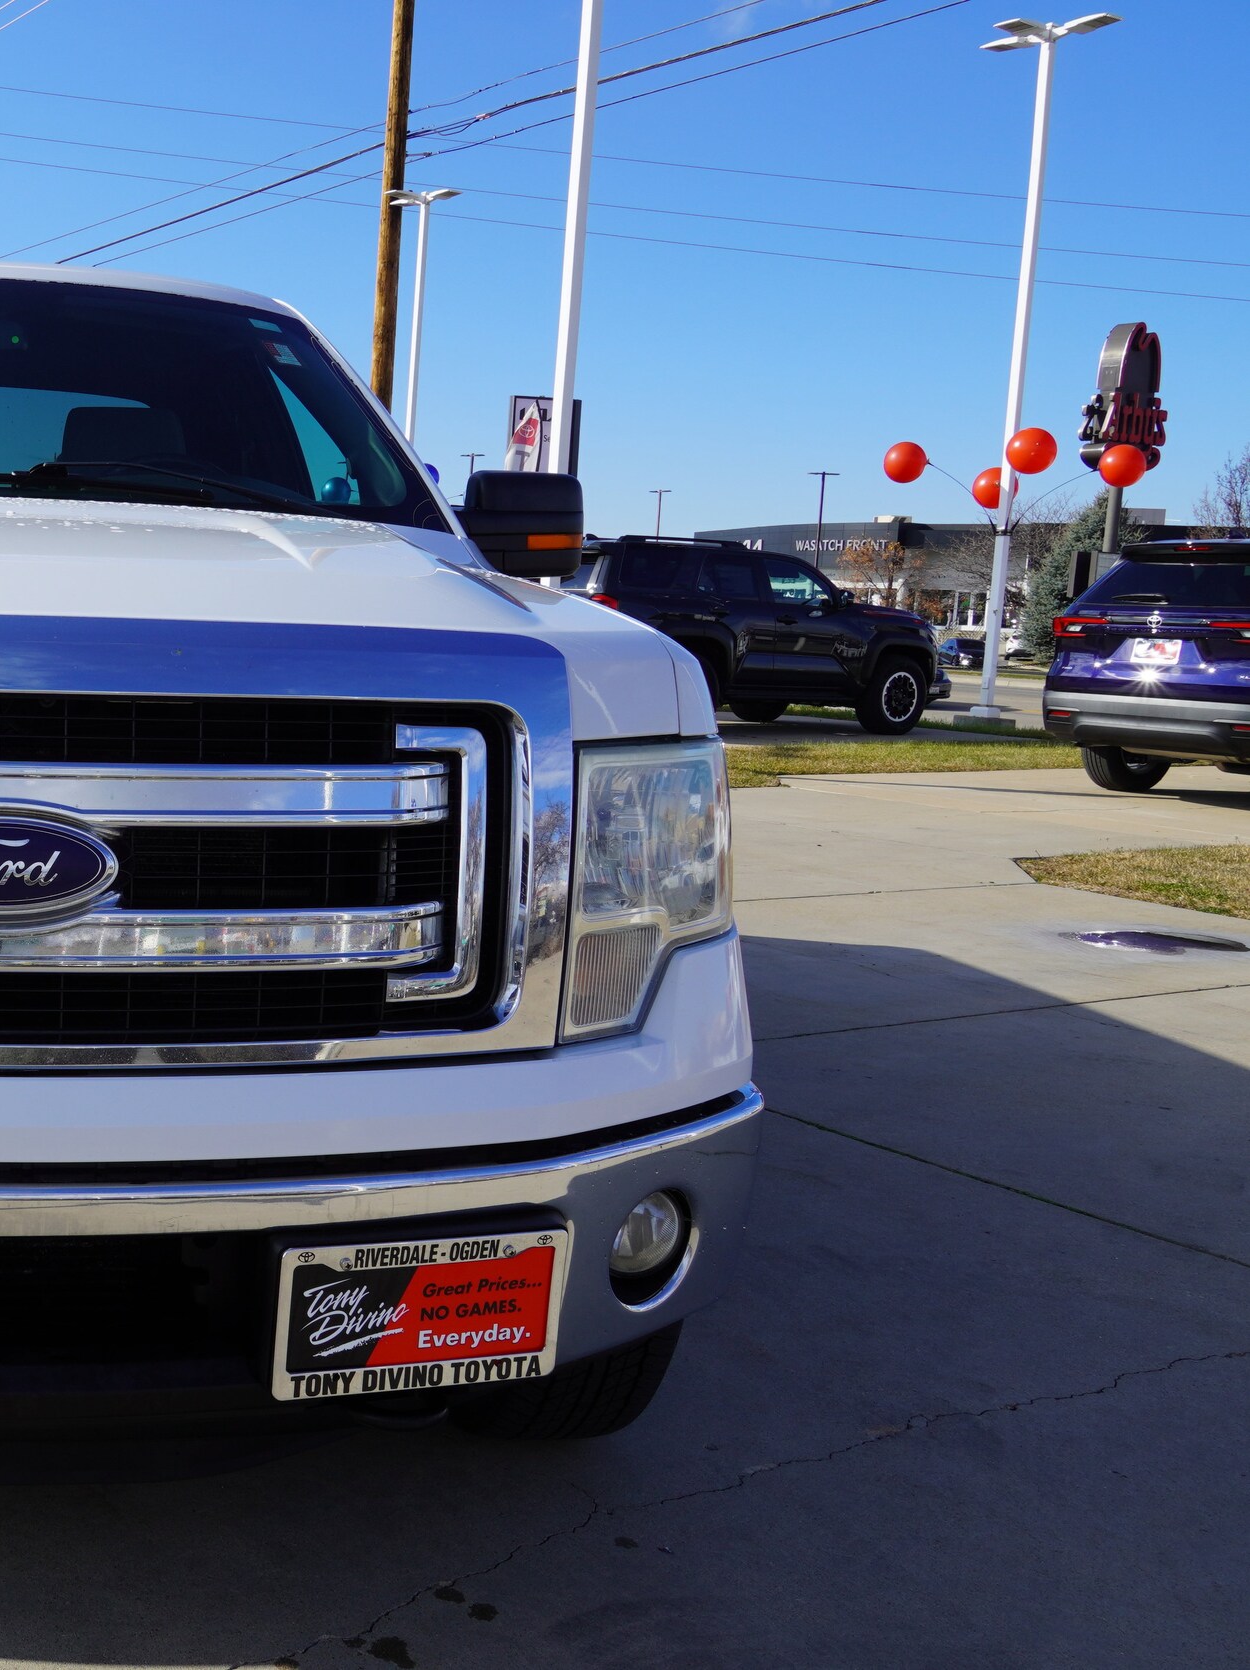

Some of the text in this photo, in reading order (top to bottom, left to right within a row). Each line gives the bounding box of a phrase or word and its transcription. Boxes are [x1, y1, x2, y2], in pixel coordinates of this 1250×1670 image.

[795, 539, 843, 552] WASATCH
[353, 1243, 438, 1269] RIVERDALE
[449, 1239, 500, 1262] OGDEN
[303, 1278, 369, 1318] Tony
[422, 1276, 543, 1298] Great Prices...
[300, 1301, 410, 1346] Divino
[420, 1299, 522, 1322] NO GAMES.
[417, 1323, 531, 1349] Everyday.
[291, 1354, 542, 1398] TONY DIVINO TOYOTA
